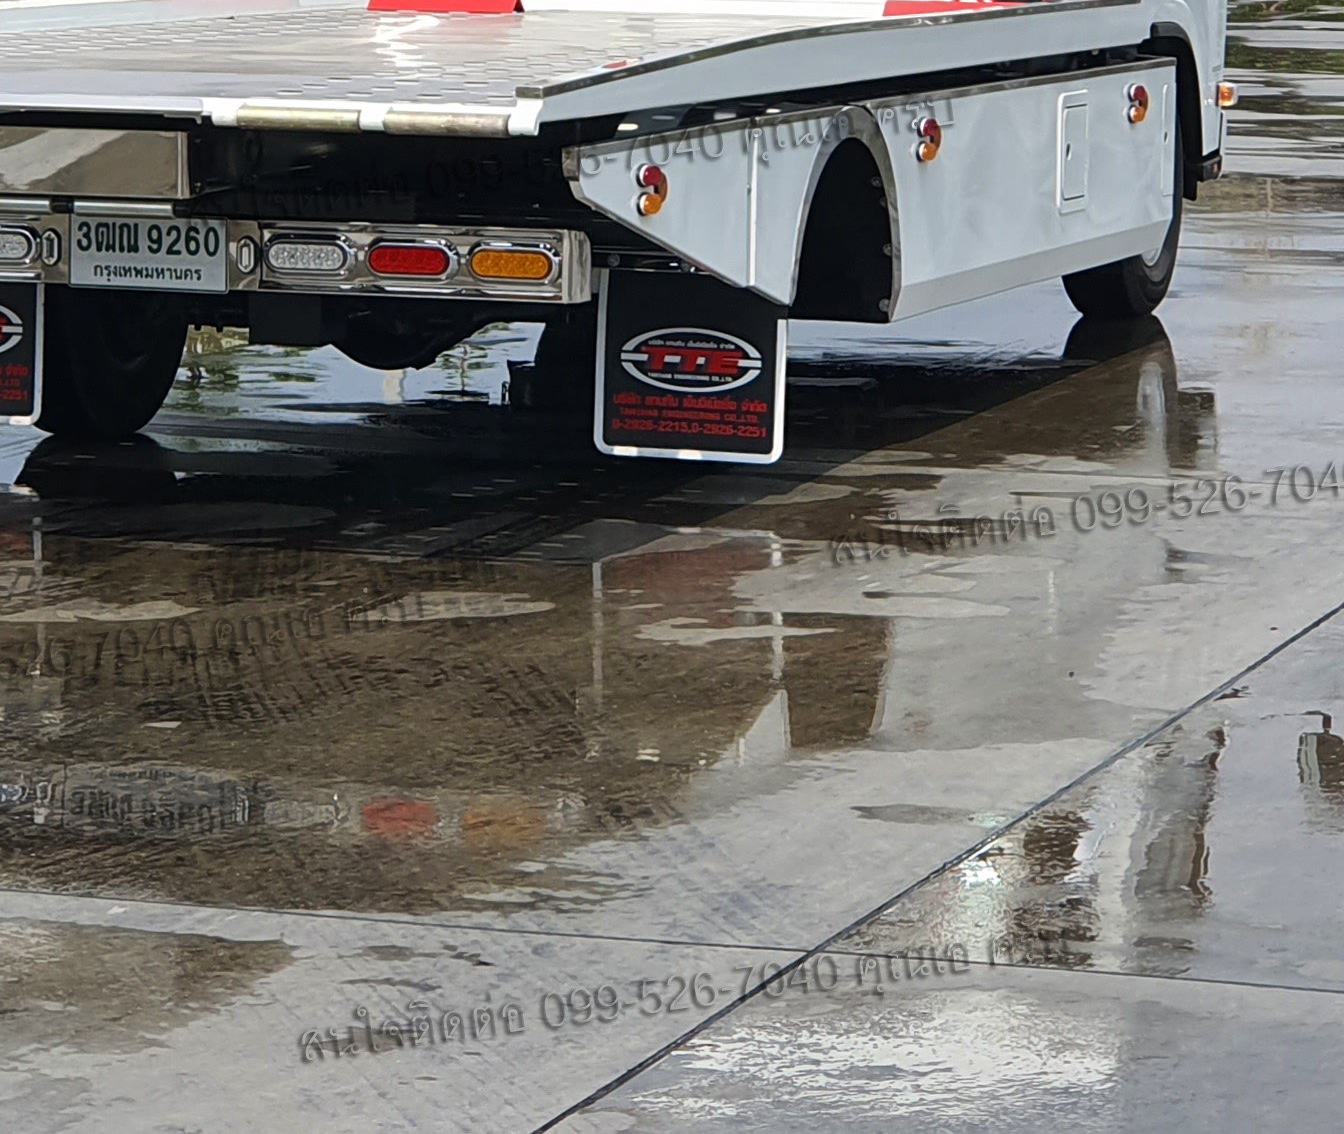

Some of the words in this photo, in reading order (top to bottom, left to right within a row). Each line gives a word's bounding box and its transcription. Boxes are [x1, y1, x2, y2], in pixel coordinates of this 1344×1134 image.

[146, 224, 220, 257] 9260
[93, 264, 202, 283] กรุงเทพมหานคร
[642, 346, 744, 375] TTE
